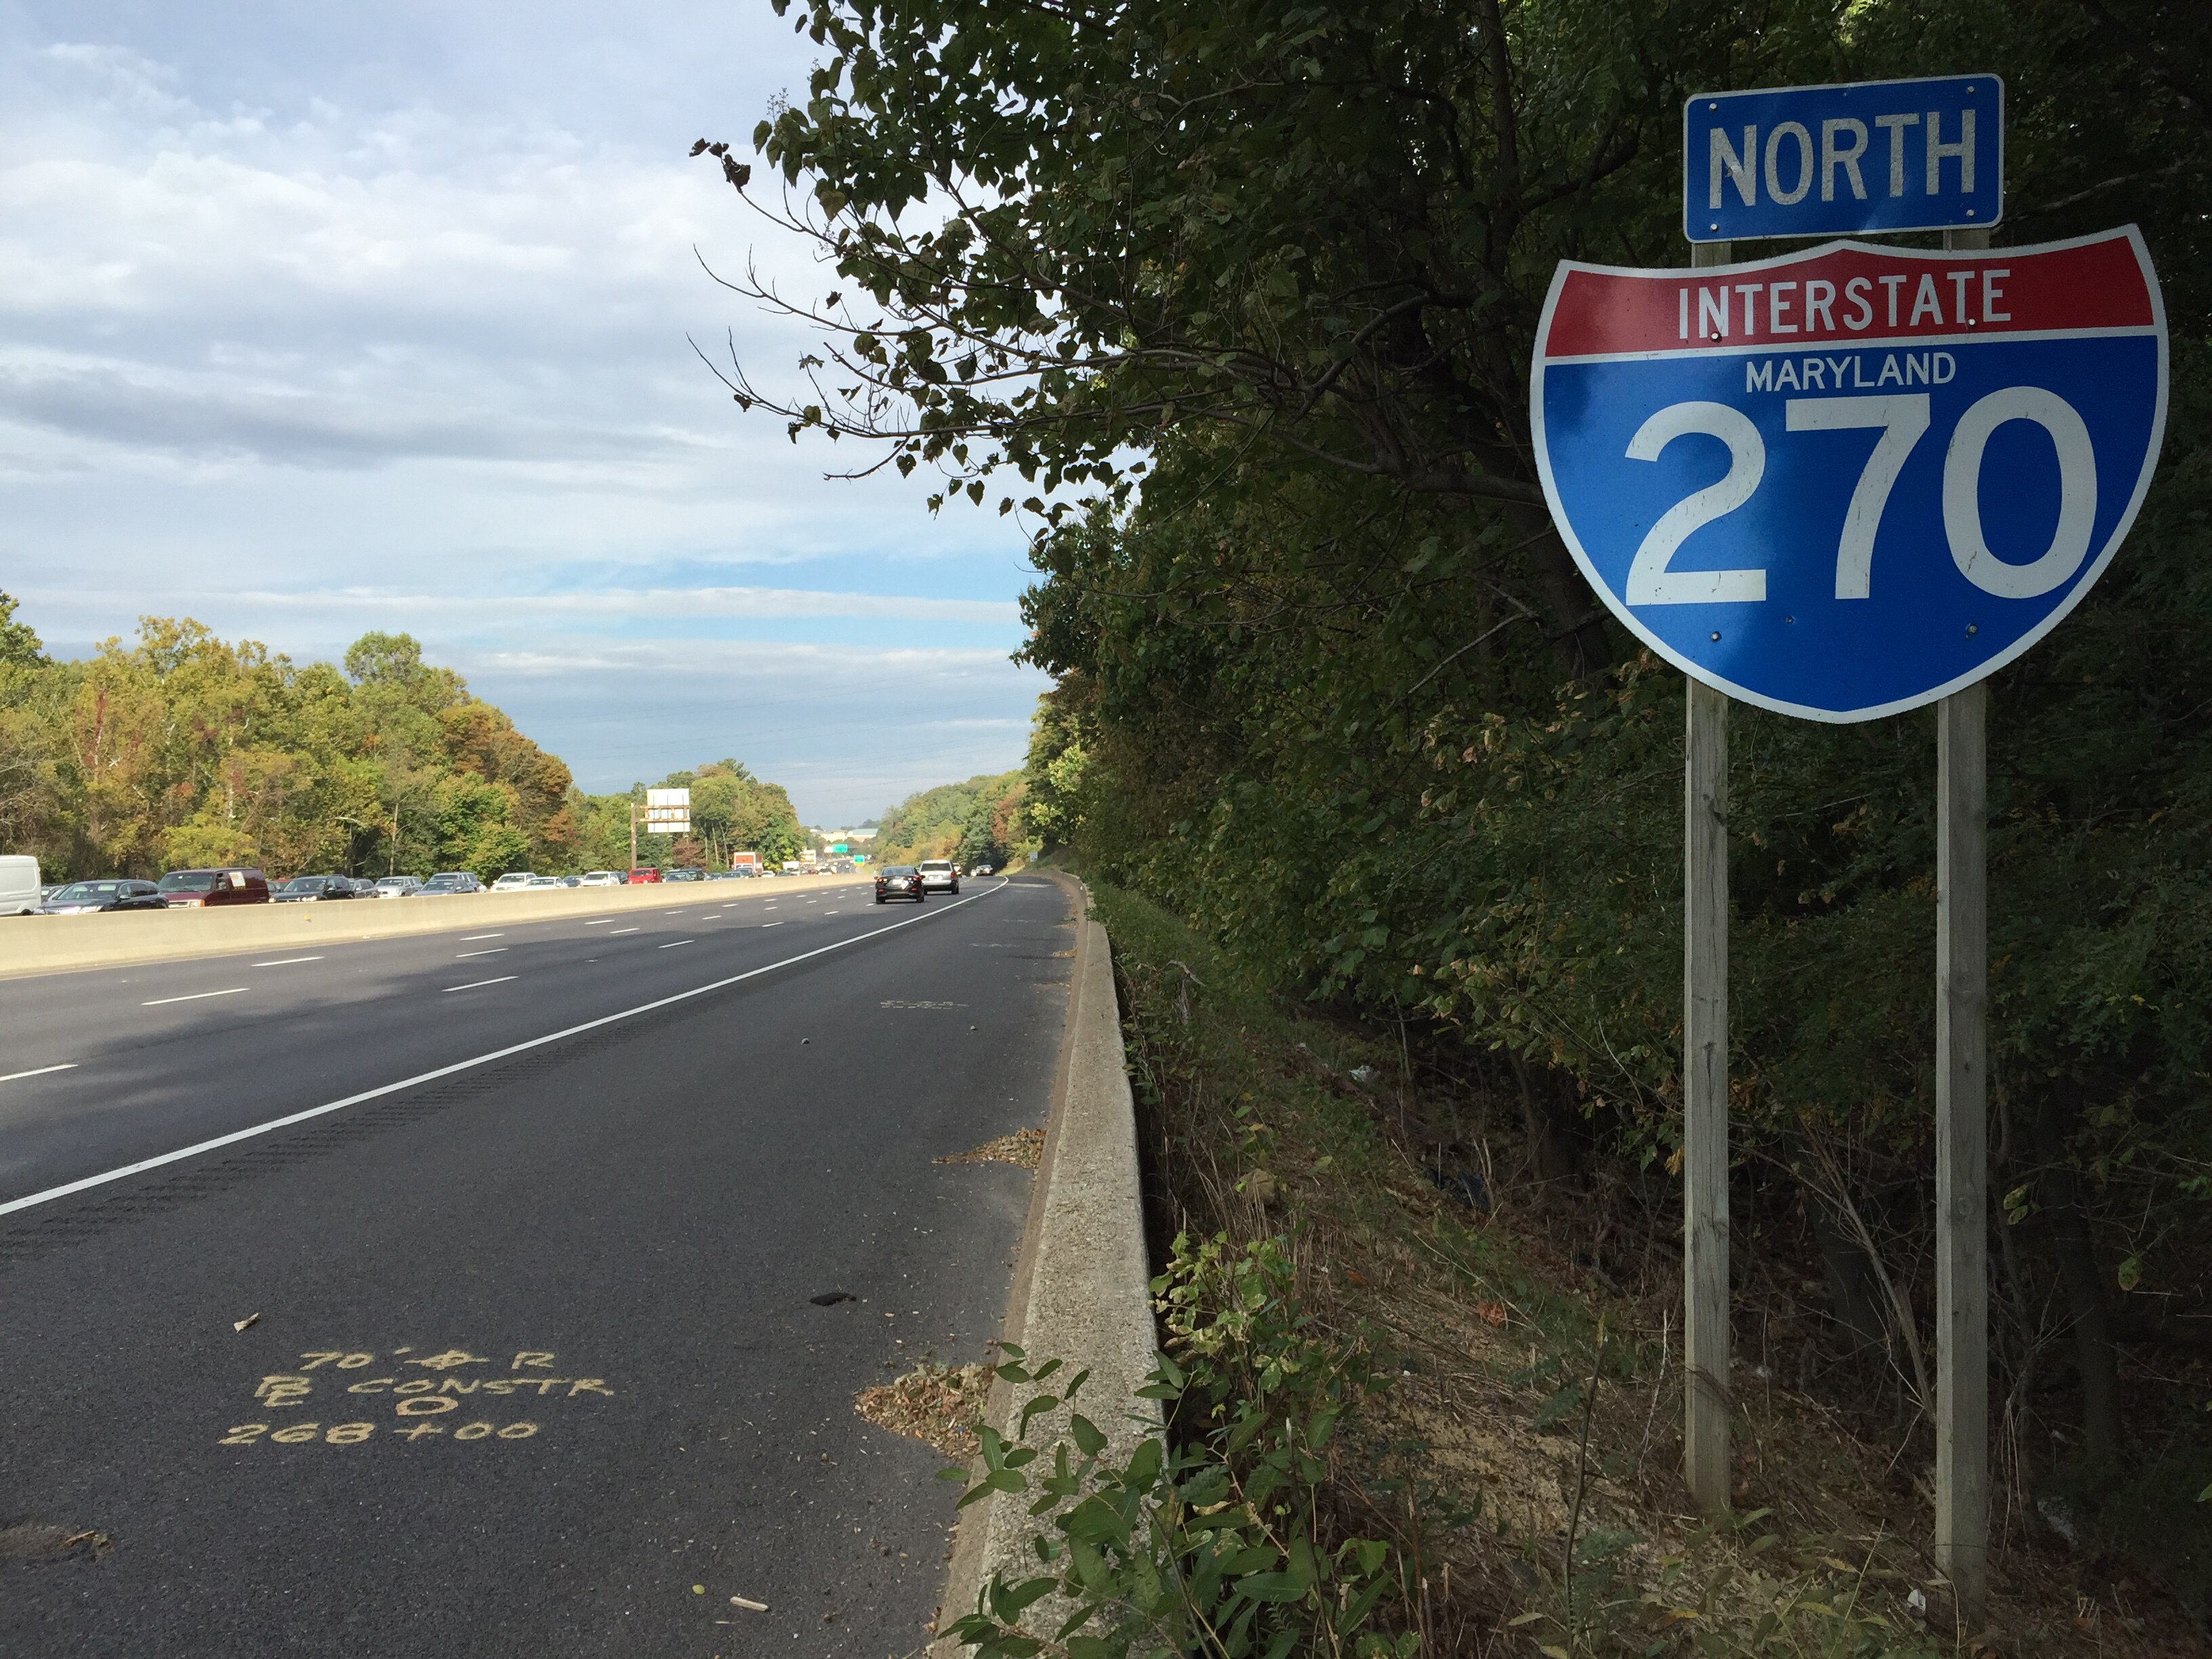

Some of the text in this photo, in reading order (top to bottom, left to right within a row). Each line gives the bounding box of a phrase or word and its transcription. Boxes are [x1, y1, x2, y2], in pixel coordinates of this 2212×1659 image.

[1709, 109, 1975, 209] NORTH
[1679, 269, 2011, 340] INTERSTATE
[1745, 352, 1956, 394] MARYLAND
[1624, 386, 2098, 606] 270
[347, 1378, 615, 1397] CONSTR
[512, 1351, 556, 1370] R
